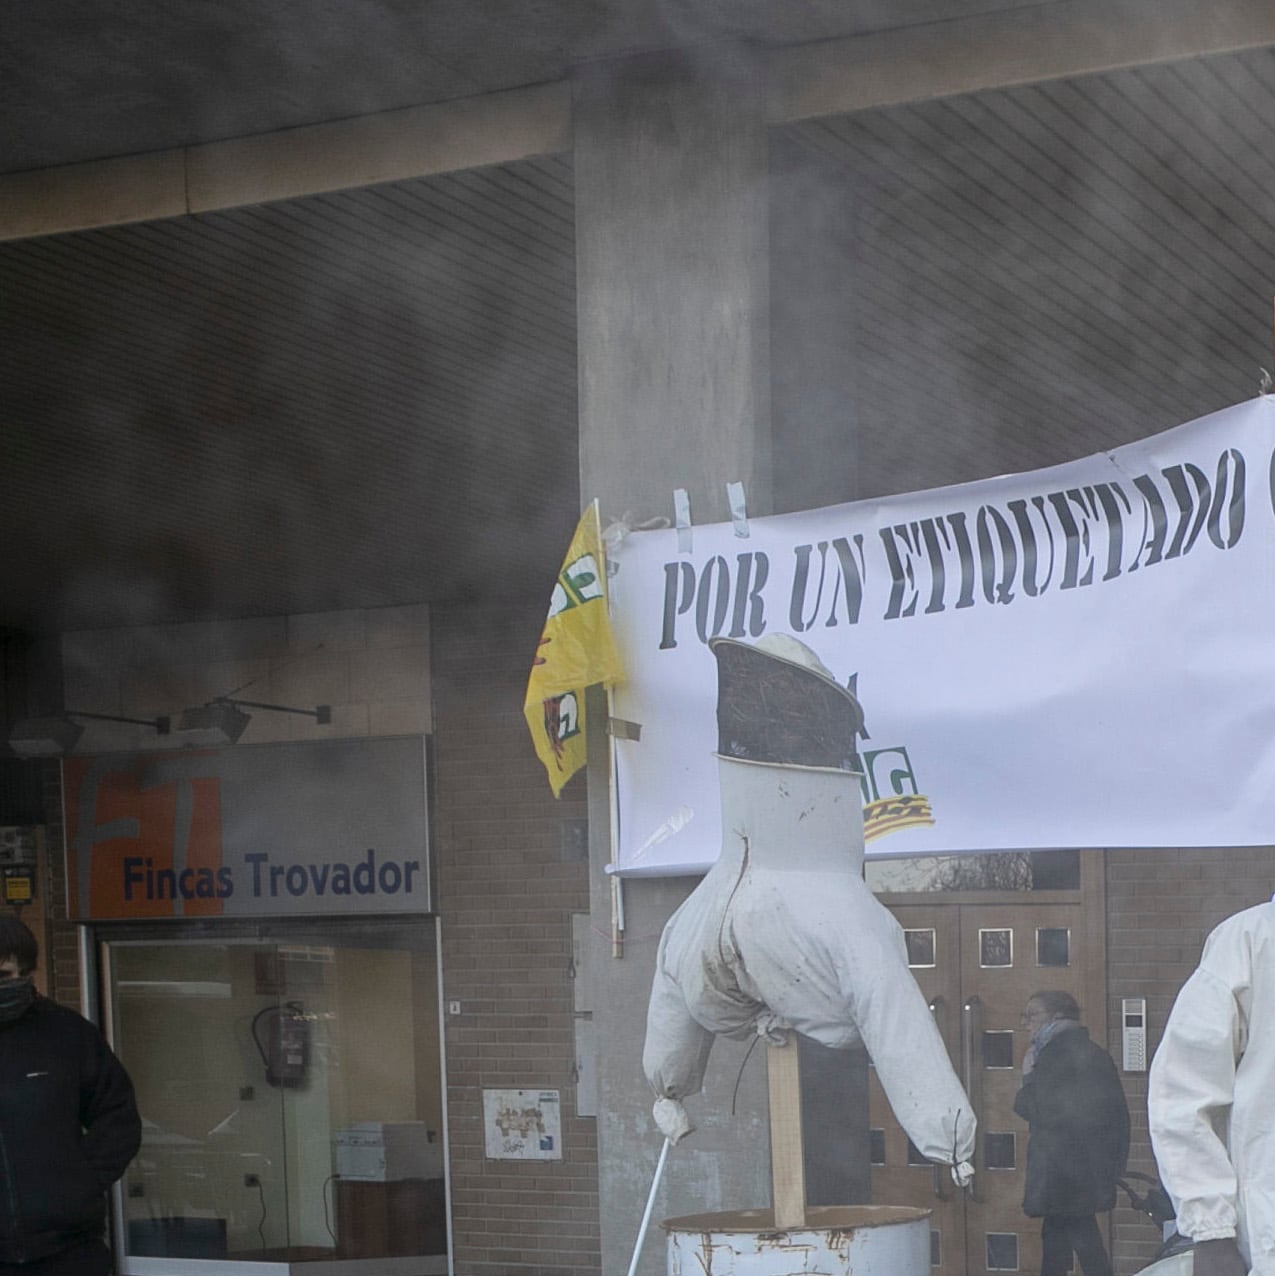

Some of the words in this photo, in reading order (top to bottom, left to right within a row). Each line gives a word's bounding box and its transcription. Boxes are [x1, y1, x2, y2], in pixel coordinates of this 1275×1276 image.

[658, 550, 769, 650] POR
[788, 534, 867, 633] UN
[878, 447, 1247, 621] ETIQUETADO
[122, 855, 234, 902] Fincas
[244, 848, 421, 899] Trovador
